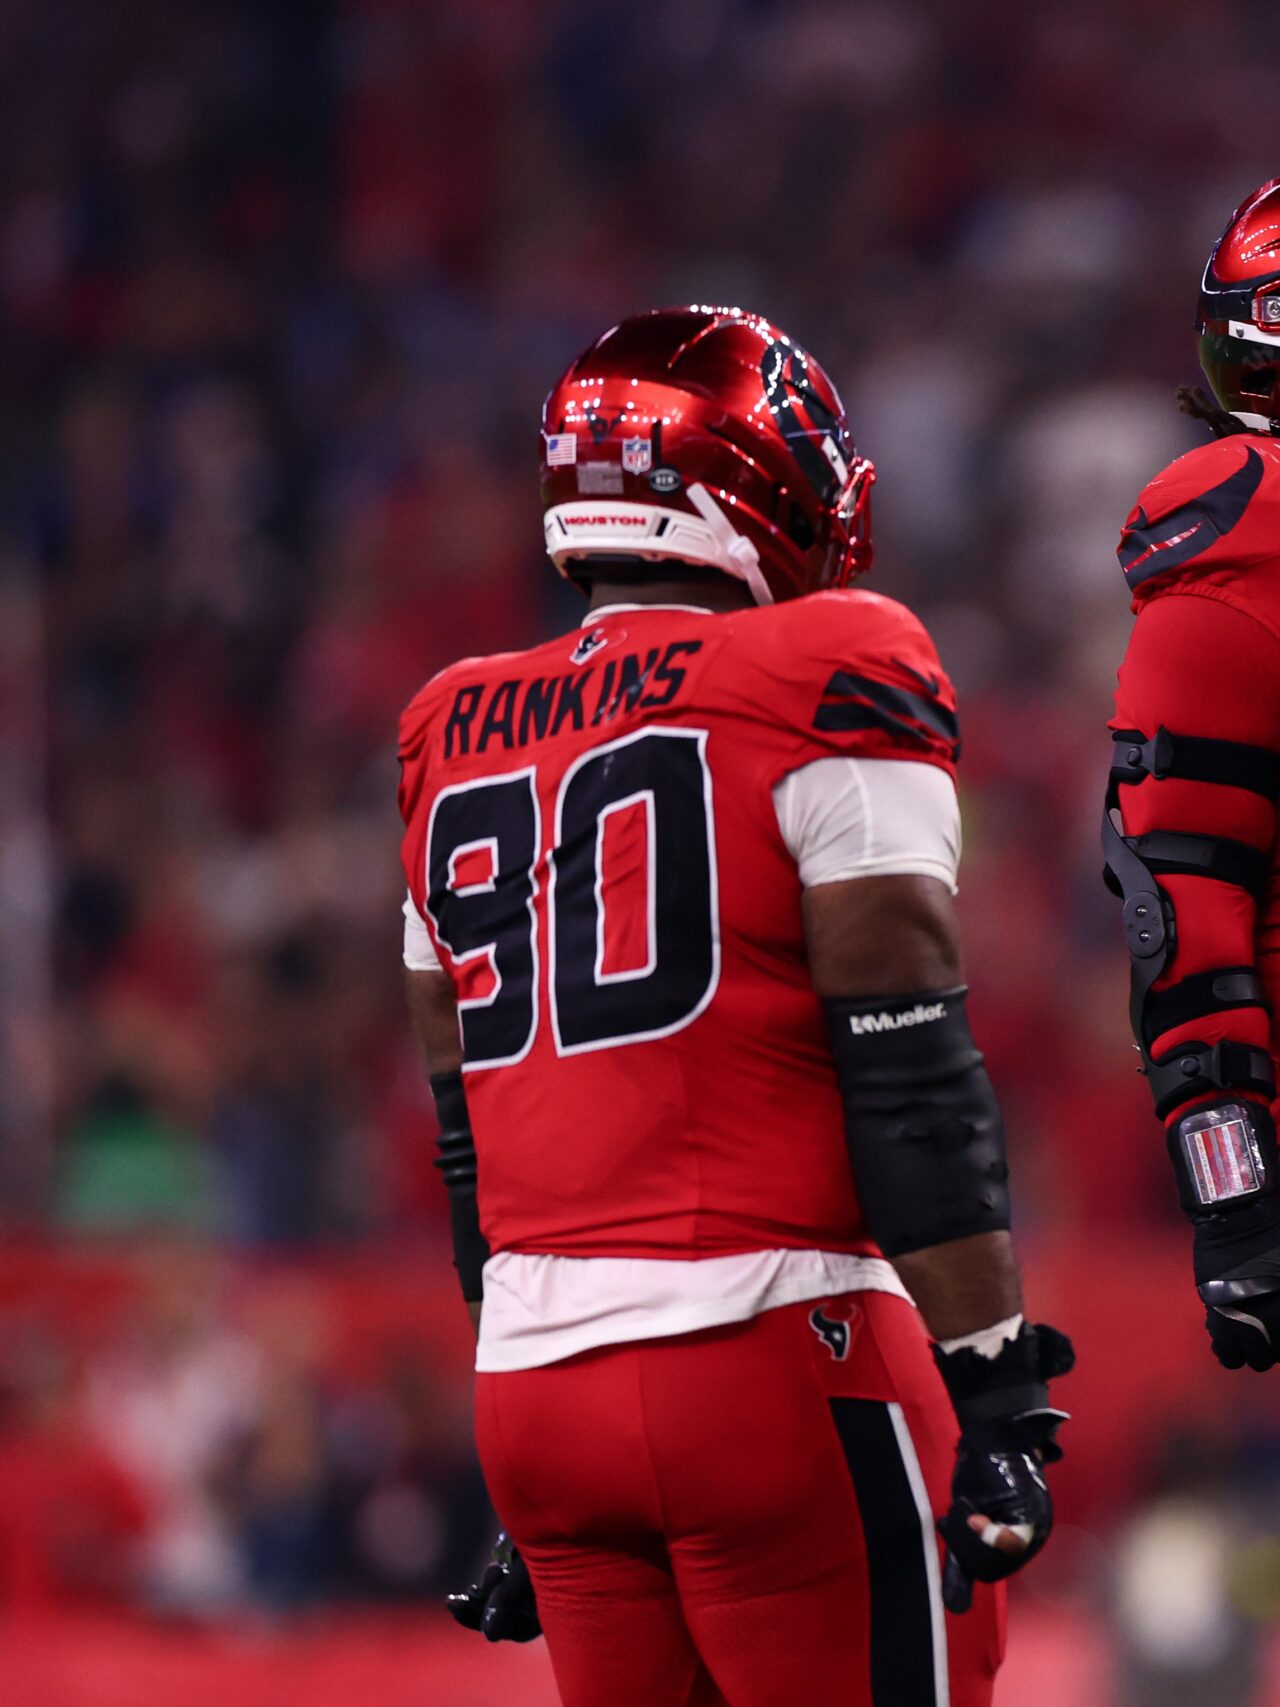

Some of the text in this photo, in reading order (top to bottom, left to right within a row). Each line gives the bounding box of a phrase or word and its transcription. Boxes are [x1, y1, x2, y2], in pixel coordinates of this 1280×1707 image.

[564, 516, 647, 526] HOUSTON
[443, 640, 703, 759] RANKINS
[425, 725, 721, 1072] 90
